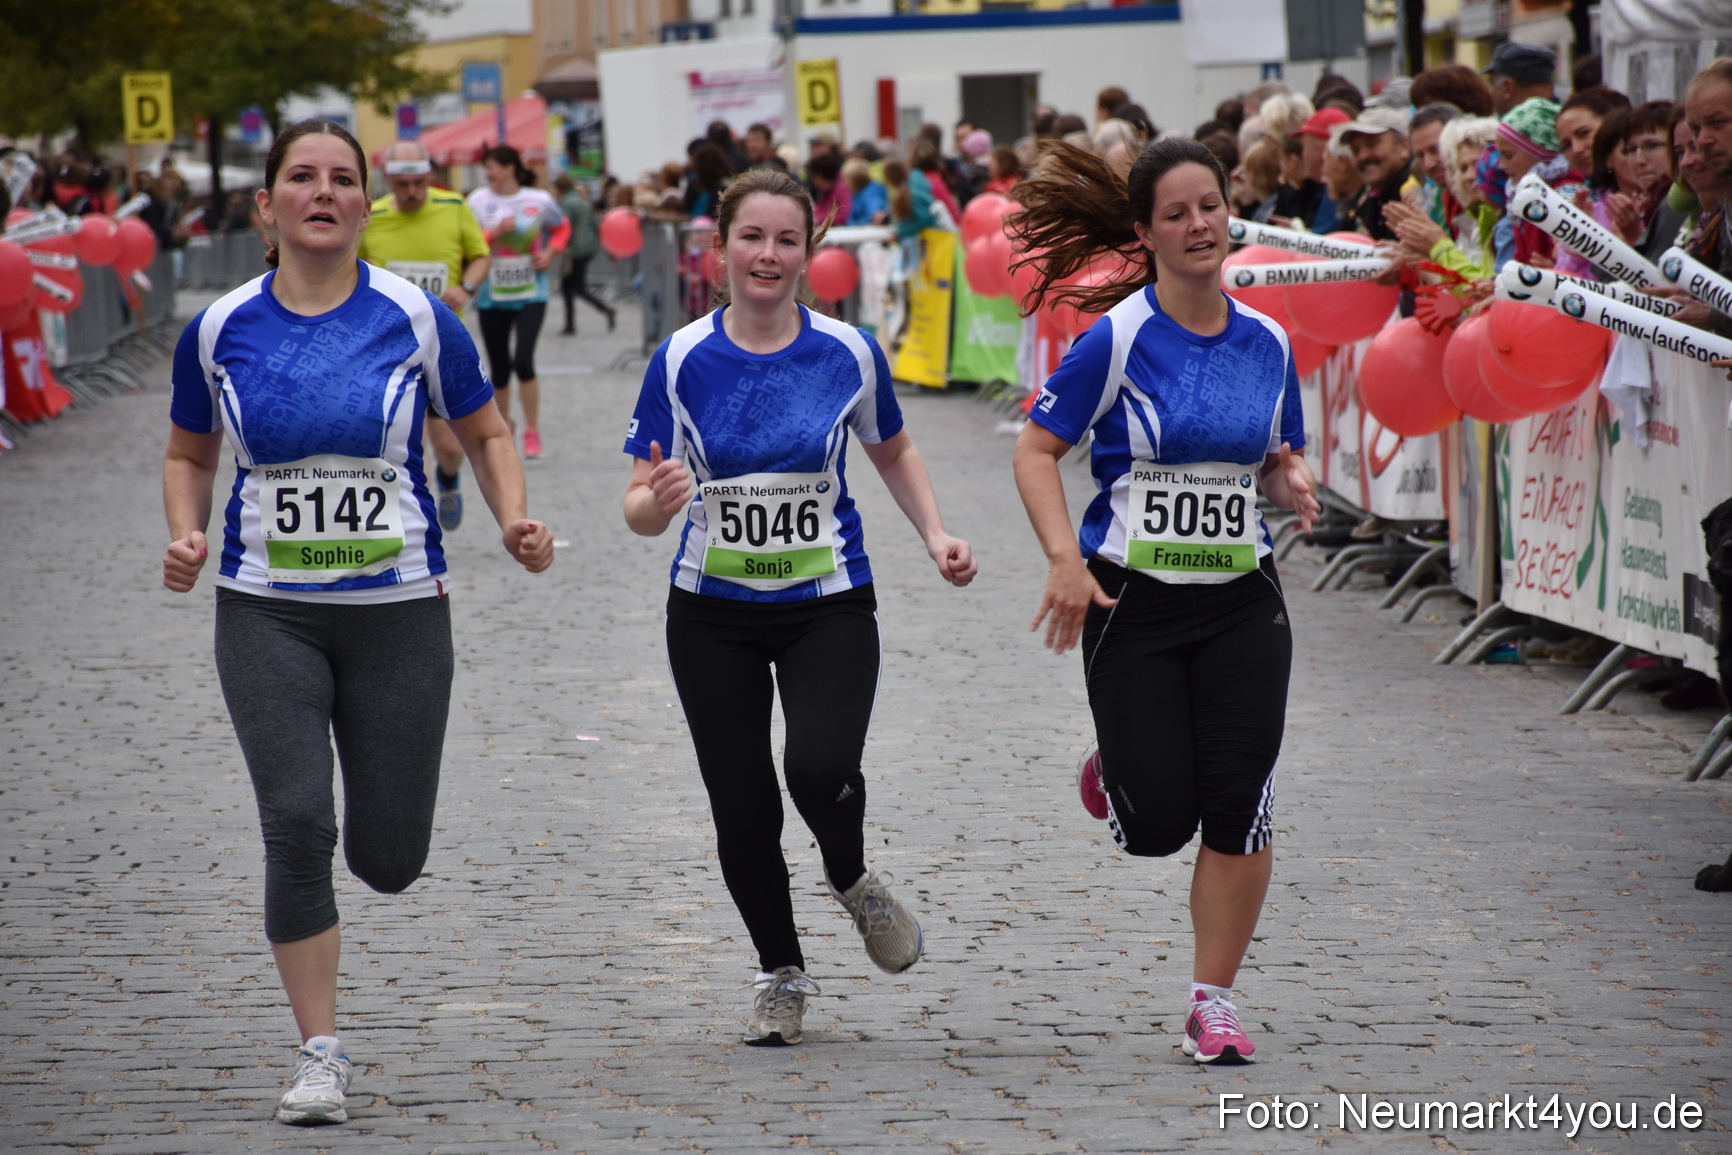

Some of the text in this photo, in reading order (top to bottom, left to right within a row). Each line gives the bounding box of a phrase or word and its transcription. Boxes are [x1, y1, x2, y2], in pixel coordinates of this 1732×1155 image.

[137, 94, 161, 128] D
[1552, 219, 1604, 259] BMW
[1598, 249, 1656, 291] Laufs
[1265, 264, 1386, 285] BMW Laufspo
[265, 467, 376, 481] PARTL Neumarkt
[1134, 471, 1237, 487] PARTL Neumarkt
[703, 483, 811, 497] PARTL Neumarkt
[276, 486, 390, 534] 5142
[1143, 490, 1246, 538] 5059
[719, 499, 820, 547] 5046
[266, 530, 273, 540] S
[711, 537, 718, 546] S
[1132, 530, 1139, 539] S
[301, 546, 365, 569] Sophie
[1153, 547, 1234, 568] Franziska
[744, 558, 793, 579] Sonja
